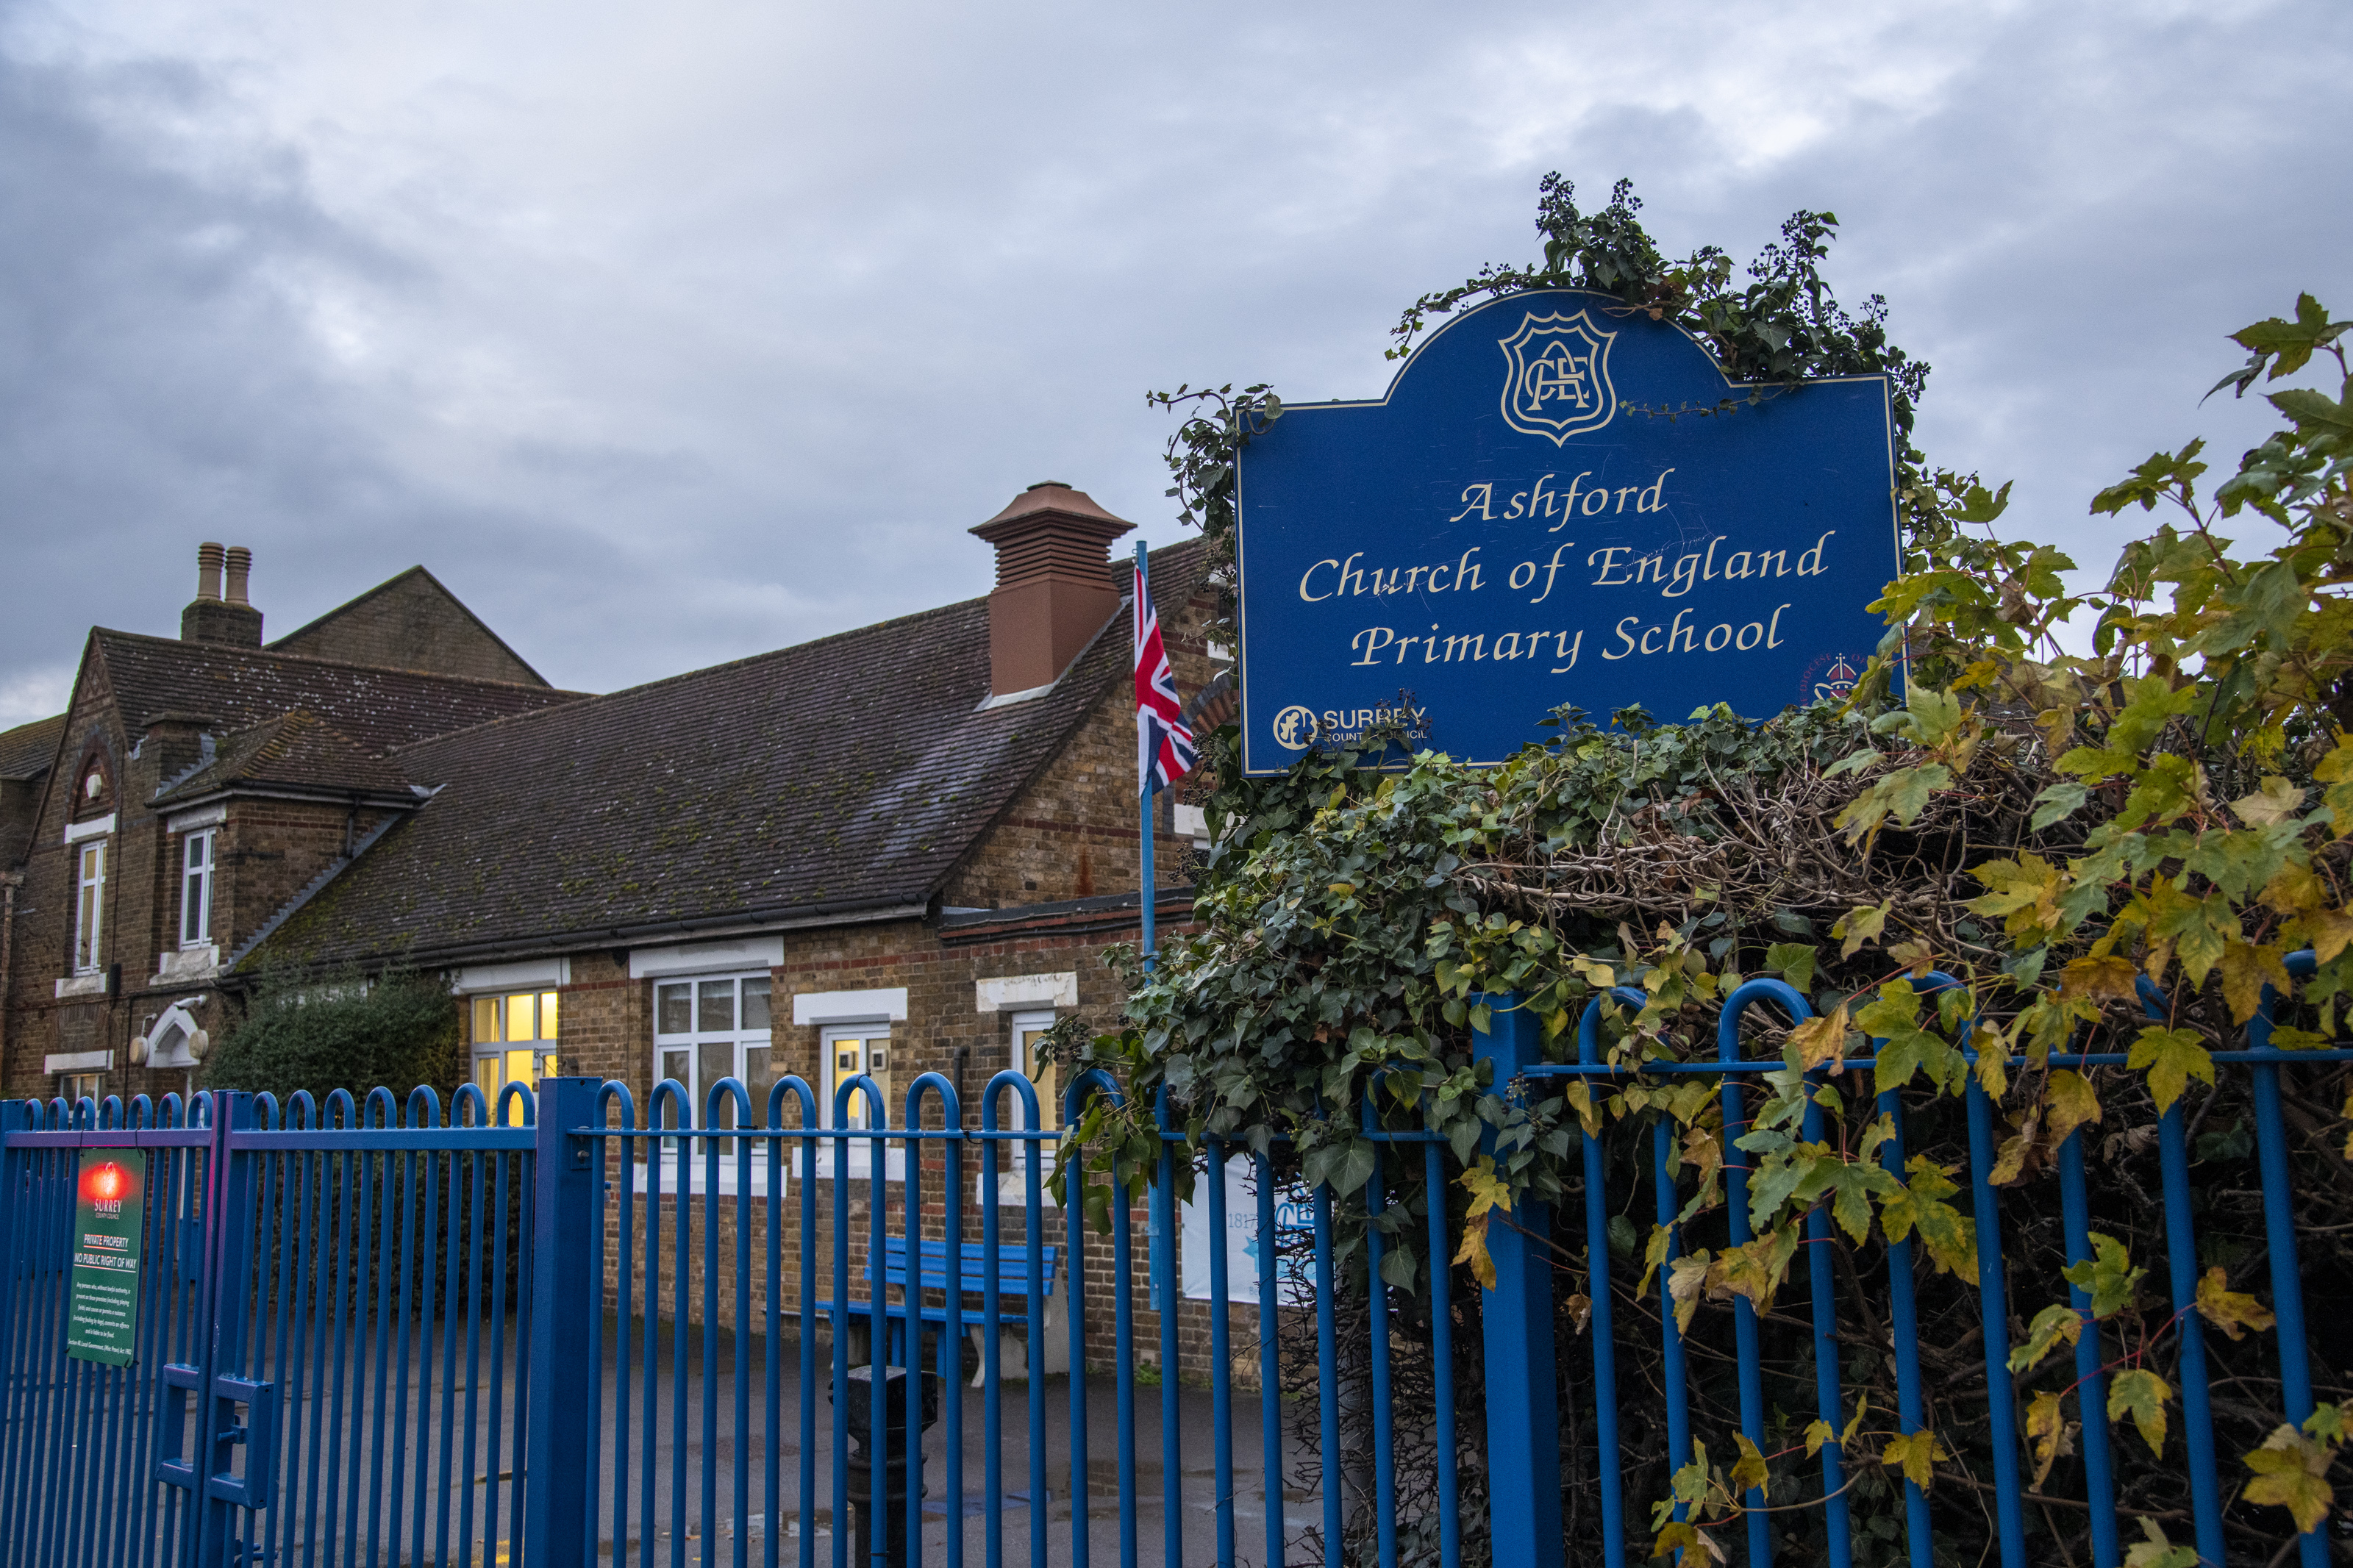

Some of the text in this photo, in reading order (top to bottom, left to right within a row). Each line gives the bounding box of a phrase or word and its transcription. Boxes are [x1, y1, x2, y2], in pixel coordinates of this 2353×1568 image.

[1449, 468, 1676, 532] Ashford
[1299, 530, 1836, 604] Church of England
[1350, 604, 1791, 673] Primary School
[1324, 732, 1365, 742] OUNT
[95, 1198, 122, 1213] SURREY
[84, 1234, 129, 1247] PRIVATE PROPERTY
[75, 1253, 137, 1269] NO PUBLIC RIGHT OF WAY
